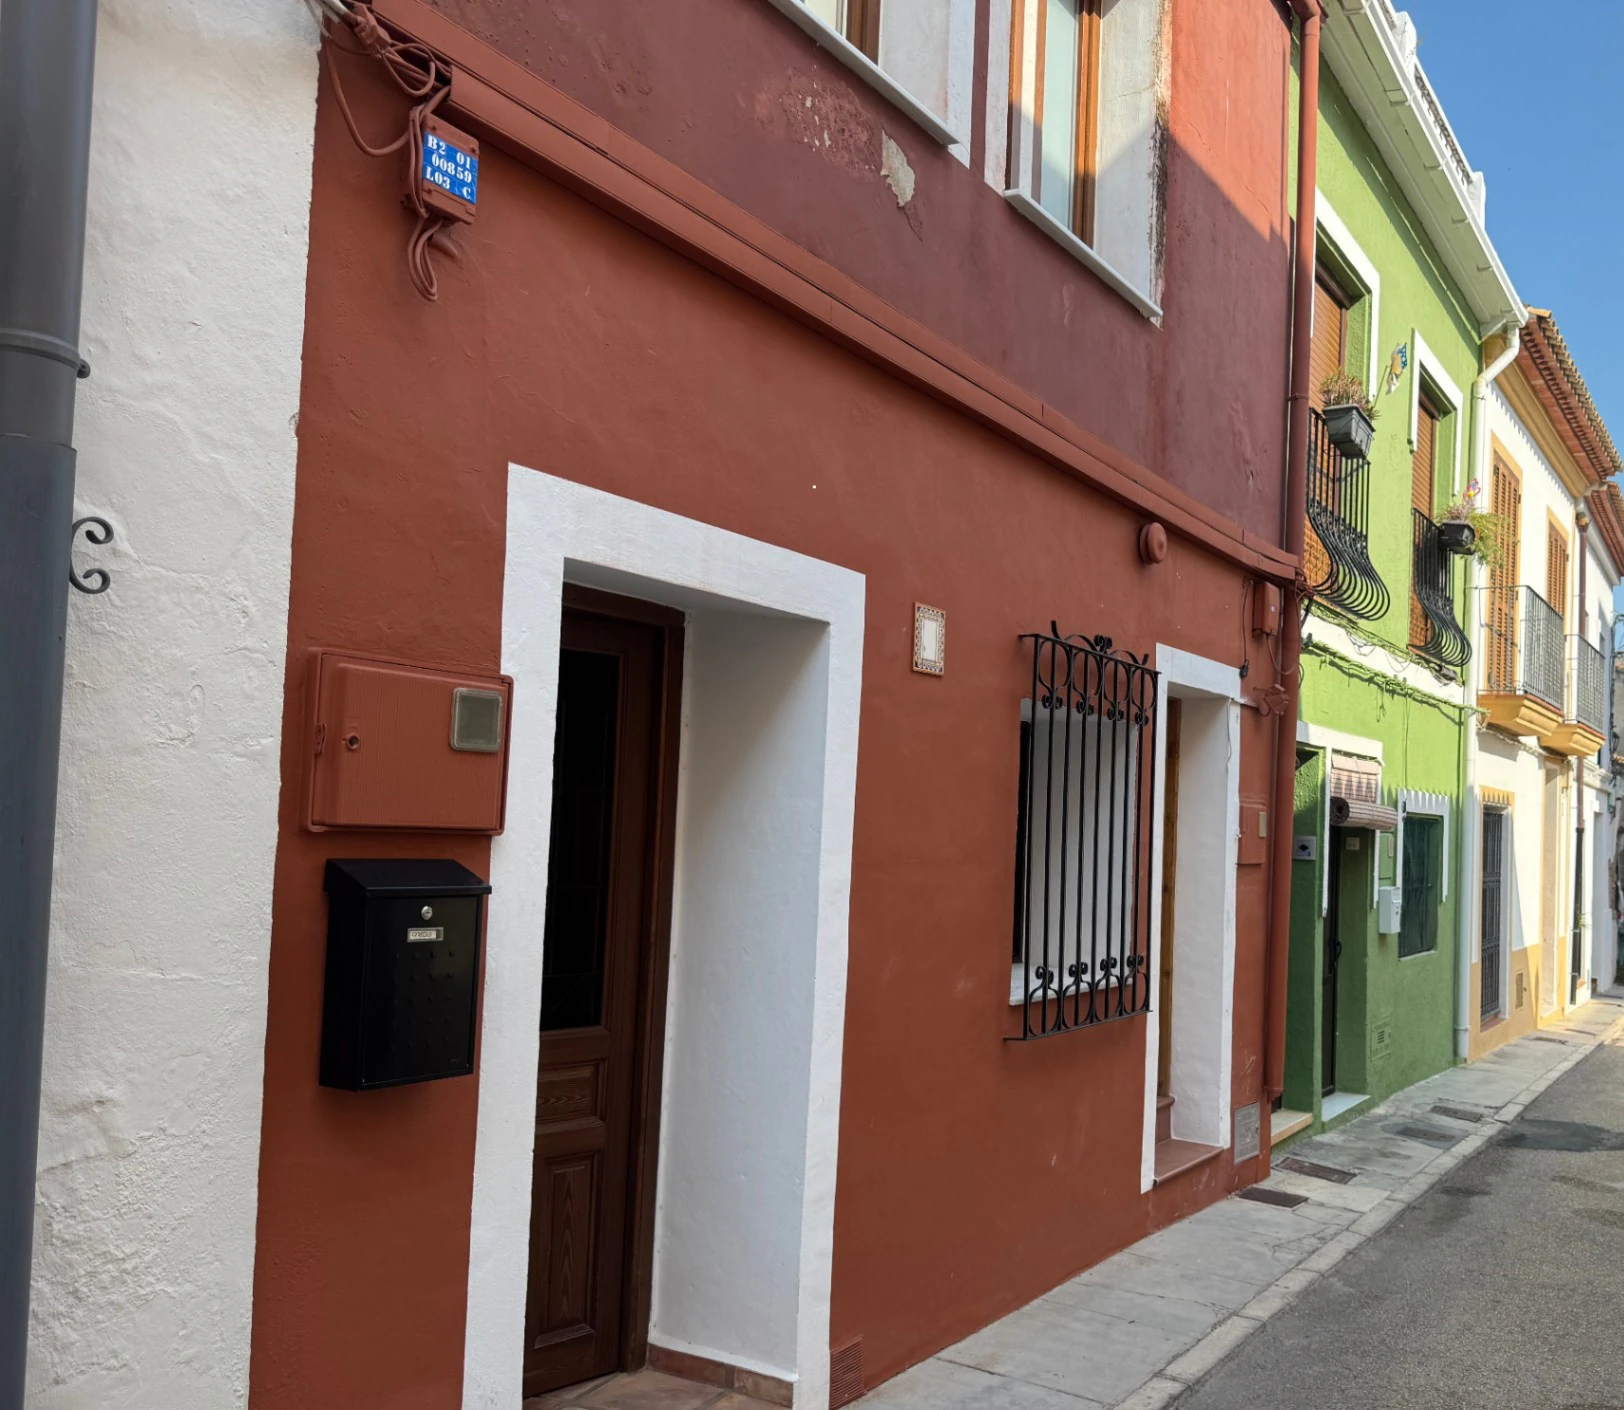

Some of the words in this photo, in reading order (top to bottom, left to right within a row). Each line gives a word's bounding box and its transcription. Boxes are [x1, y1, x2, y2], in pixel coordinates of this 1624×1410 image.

[427, 135, 446, 155] B2
[456, 152, 471, 169] 01
[432, 153, 472, 183] 00859
[426, 166, 450, 189] L03
[462, 187, 471, 199] C
